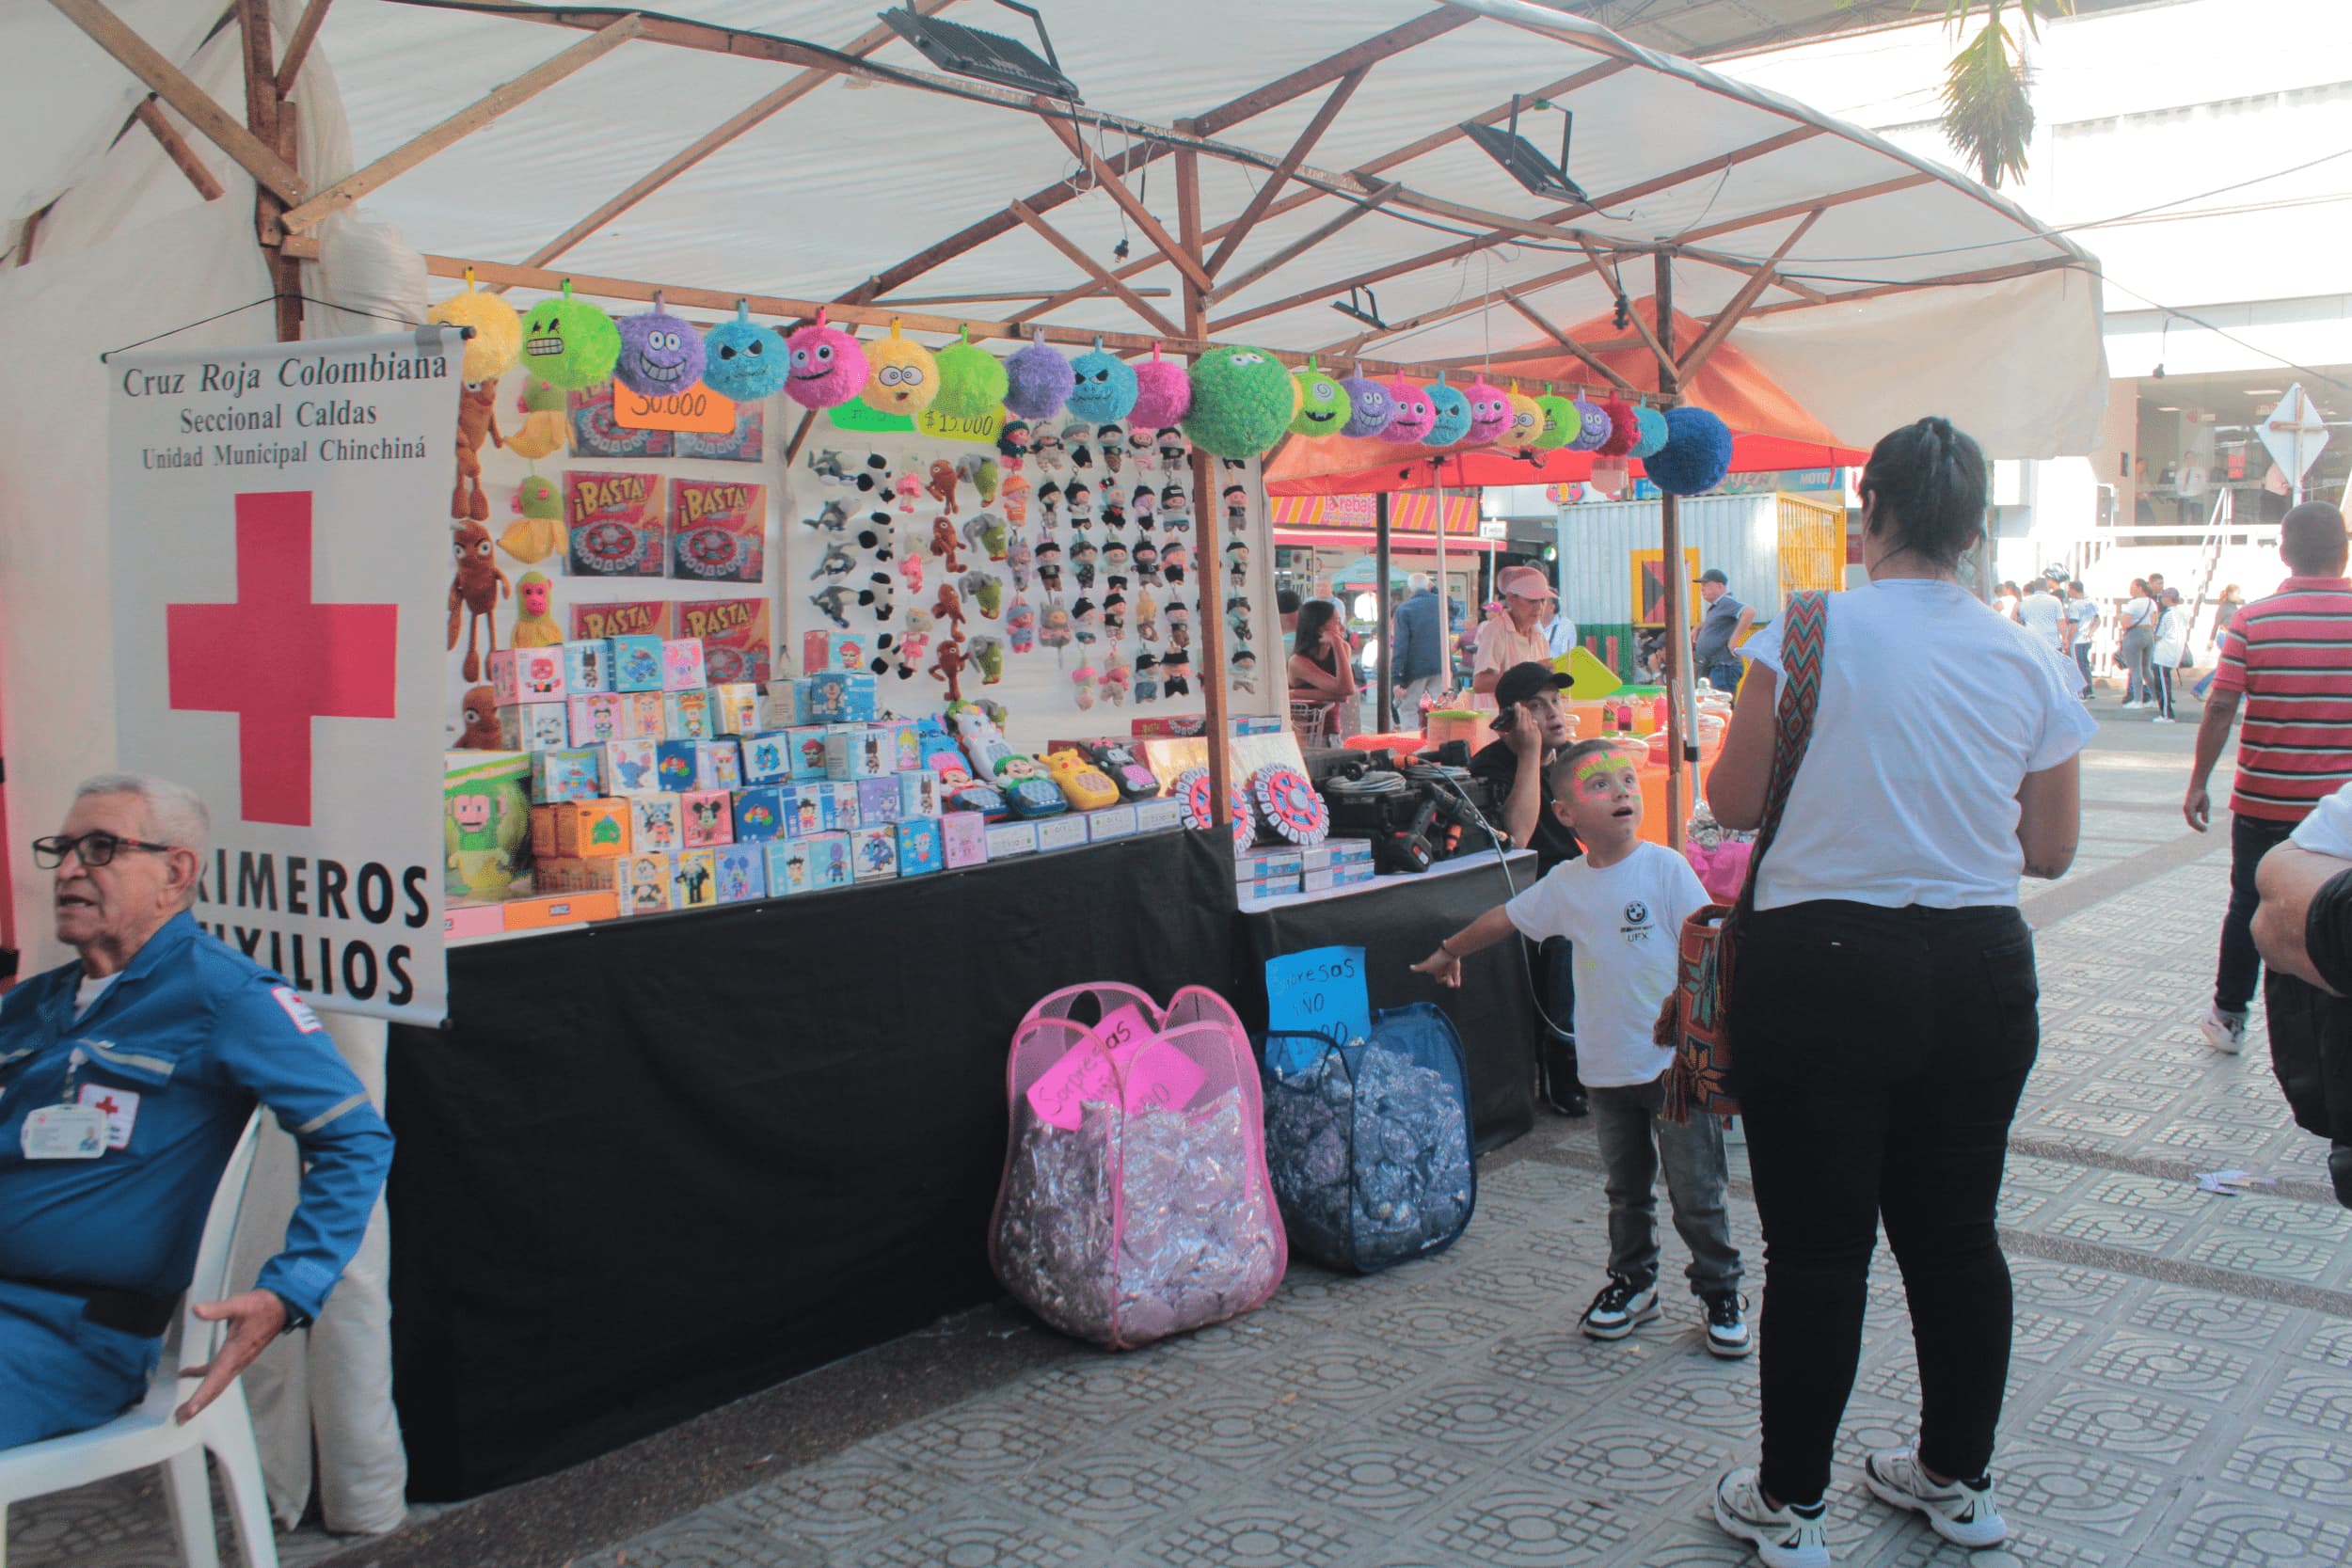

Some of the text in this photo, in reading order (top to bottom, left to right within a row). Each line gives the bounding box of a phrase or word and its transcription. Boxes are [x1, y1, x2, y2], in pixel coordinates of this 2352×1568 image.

[123, 352, 447, 398] Cruz Roja Colombiana
[181, 400, 376, 433] Seccional Caldas
[143, 436, 426, 469] Unidad Municipal Chinchiná
